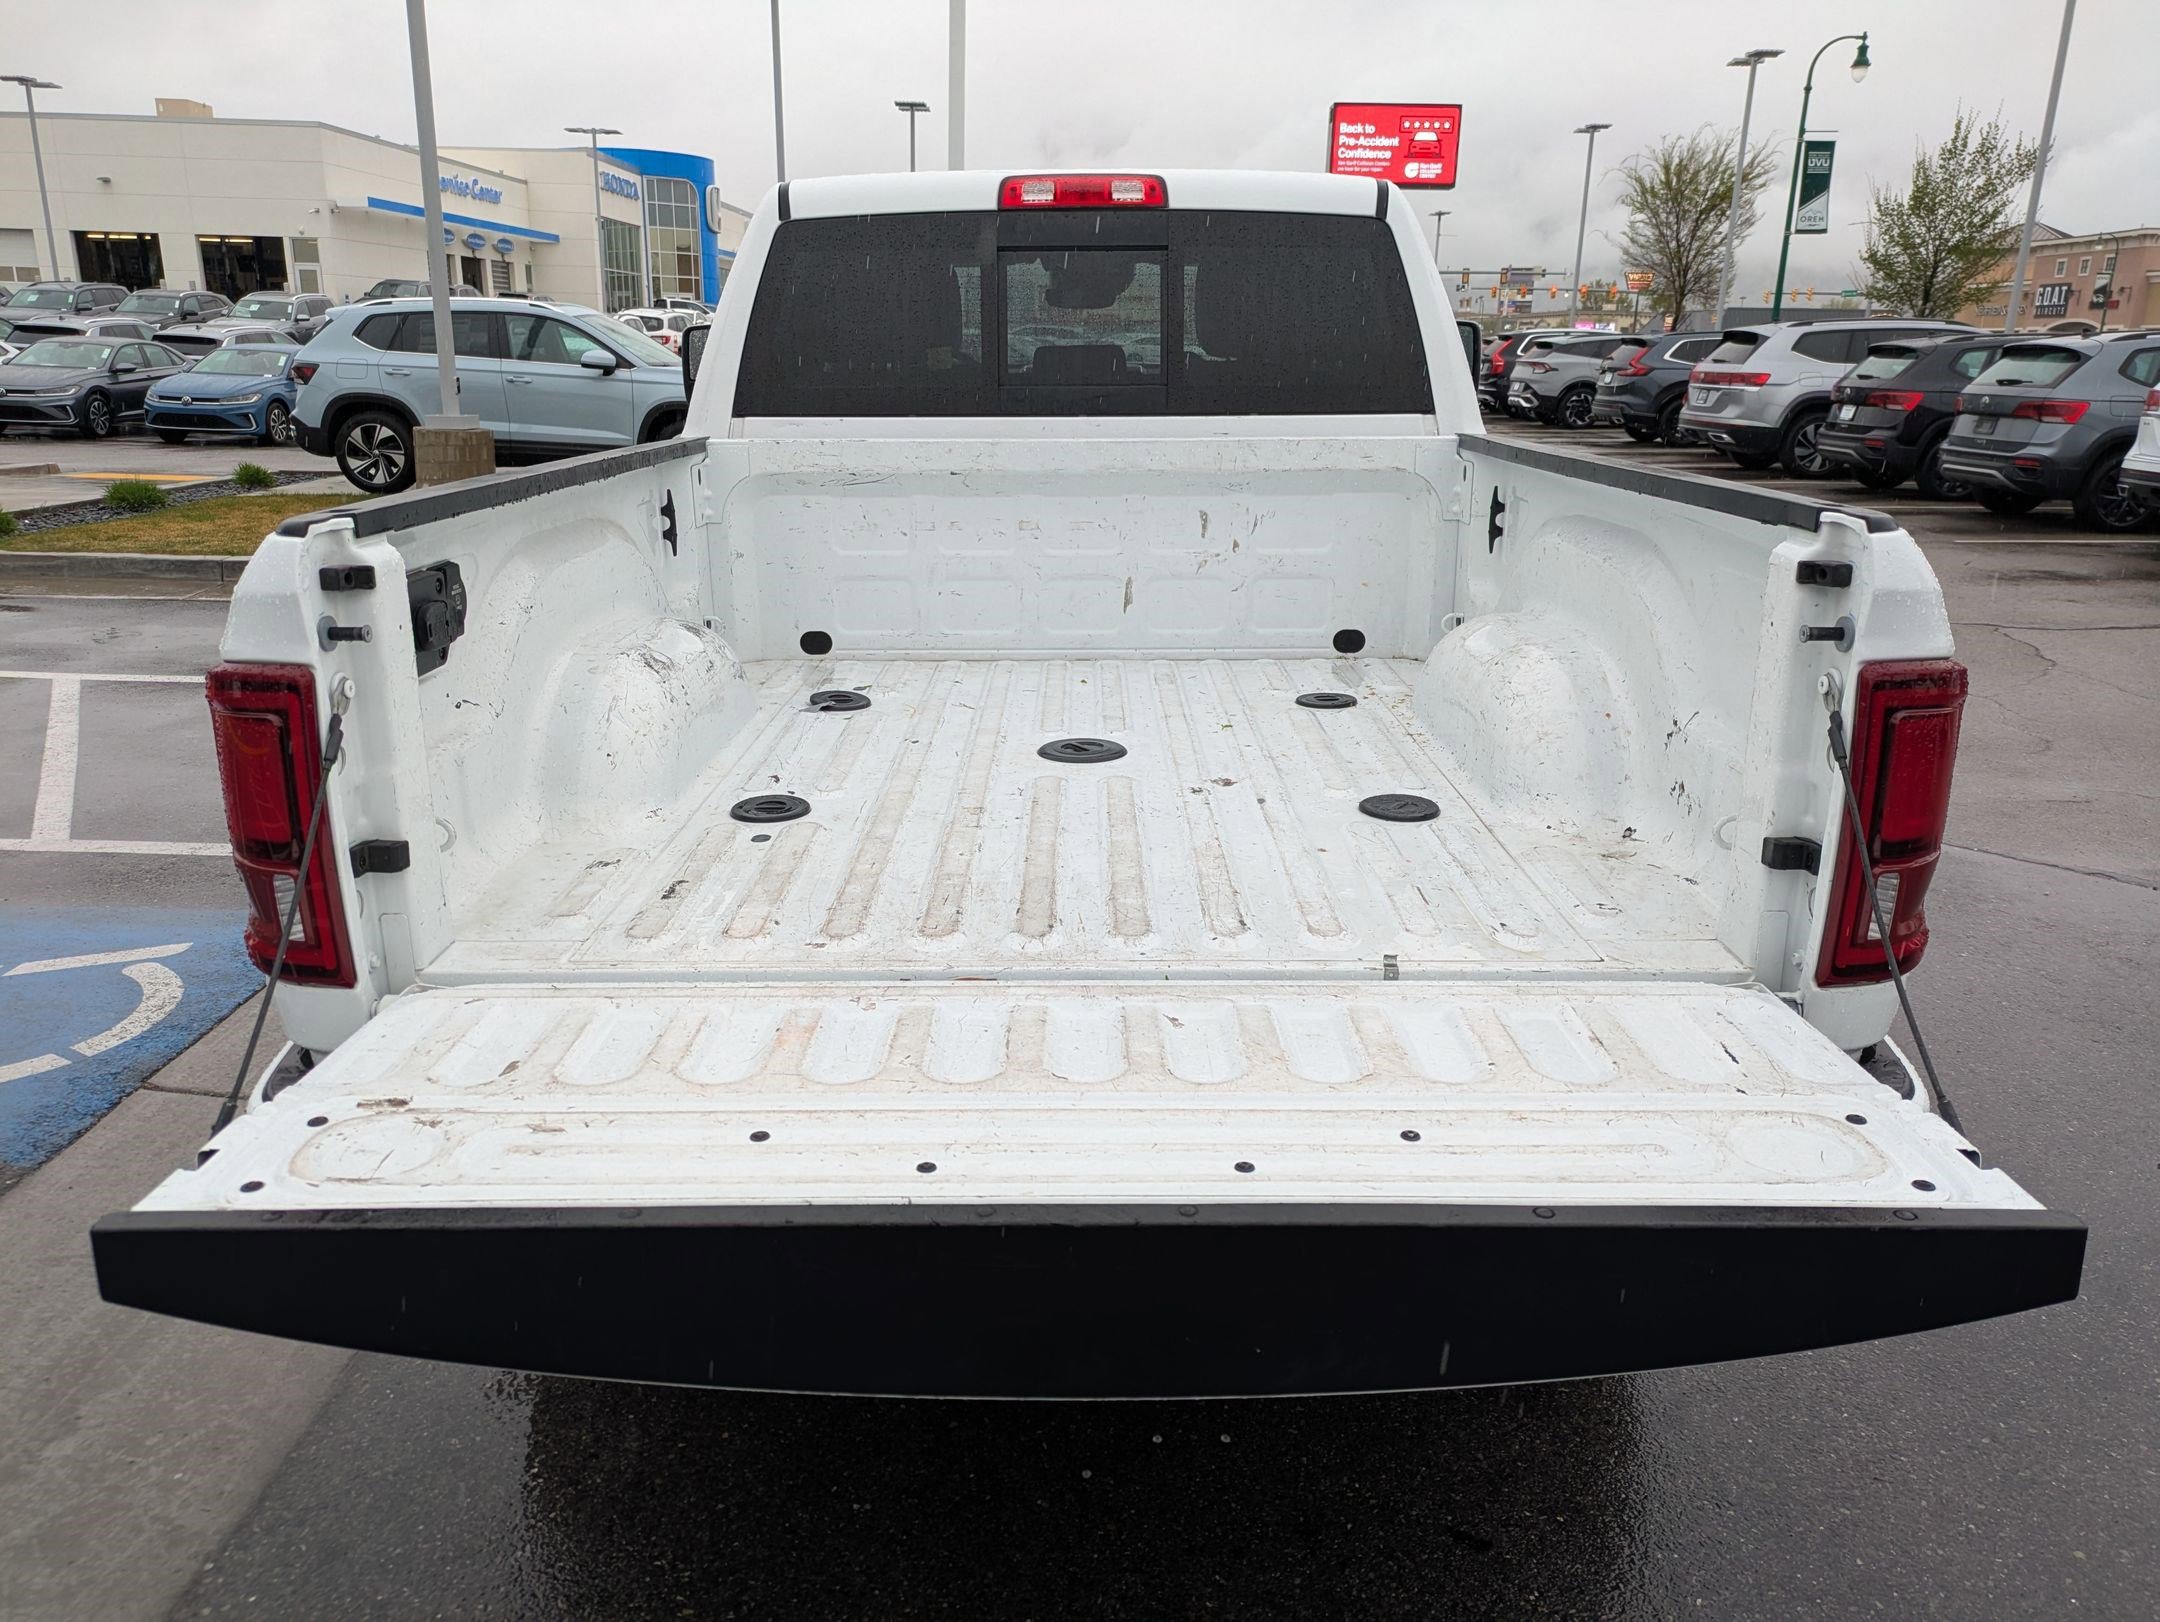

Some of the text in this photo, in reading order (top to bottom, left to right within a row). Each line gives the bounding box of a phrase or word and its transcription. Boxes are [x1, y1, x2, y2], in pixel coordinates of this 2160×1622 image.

[1340, 122, 1376, 134] Back to
[1339, 135, 1399, 146] Pre-Accident
[1338, 148, 1391, 158] Confidence
[1808, 158, 1830, 166] UVU
[439, 173, 503, 205] ervice Center
[599, 171, 641, 202] HONDA
